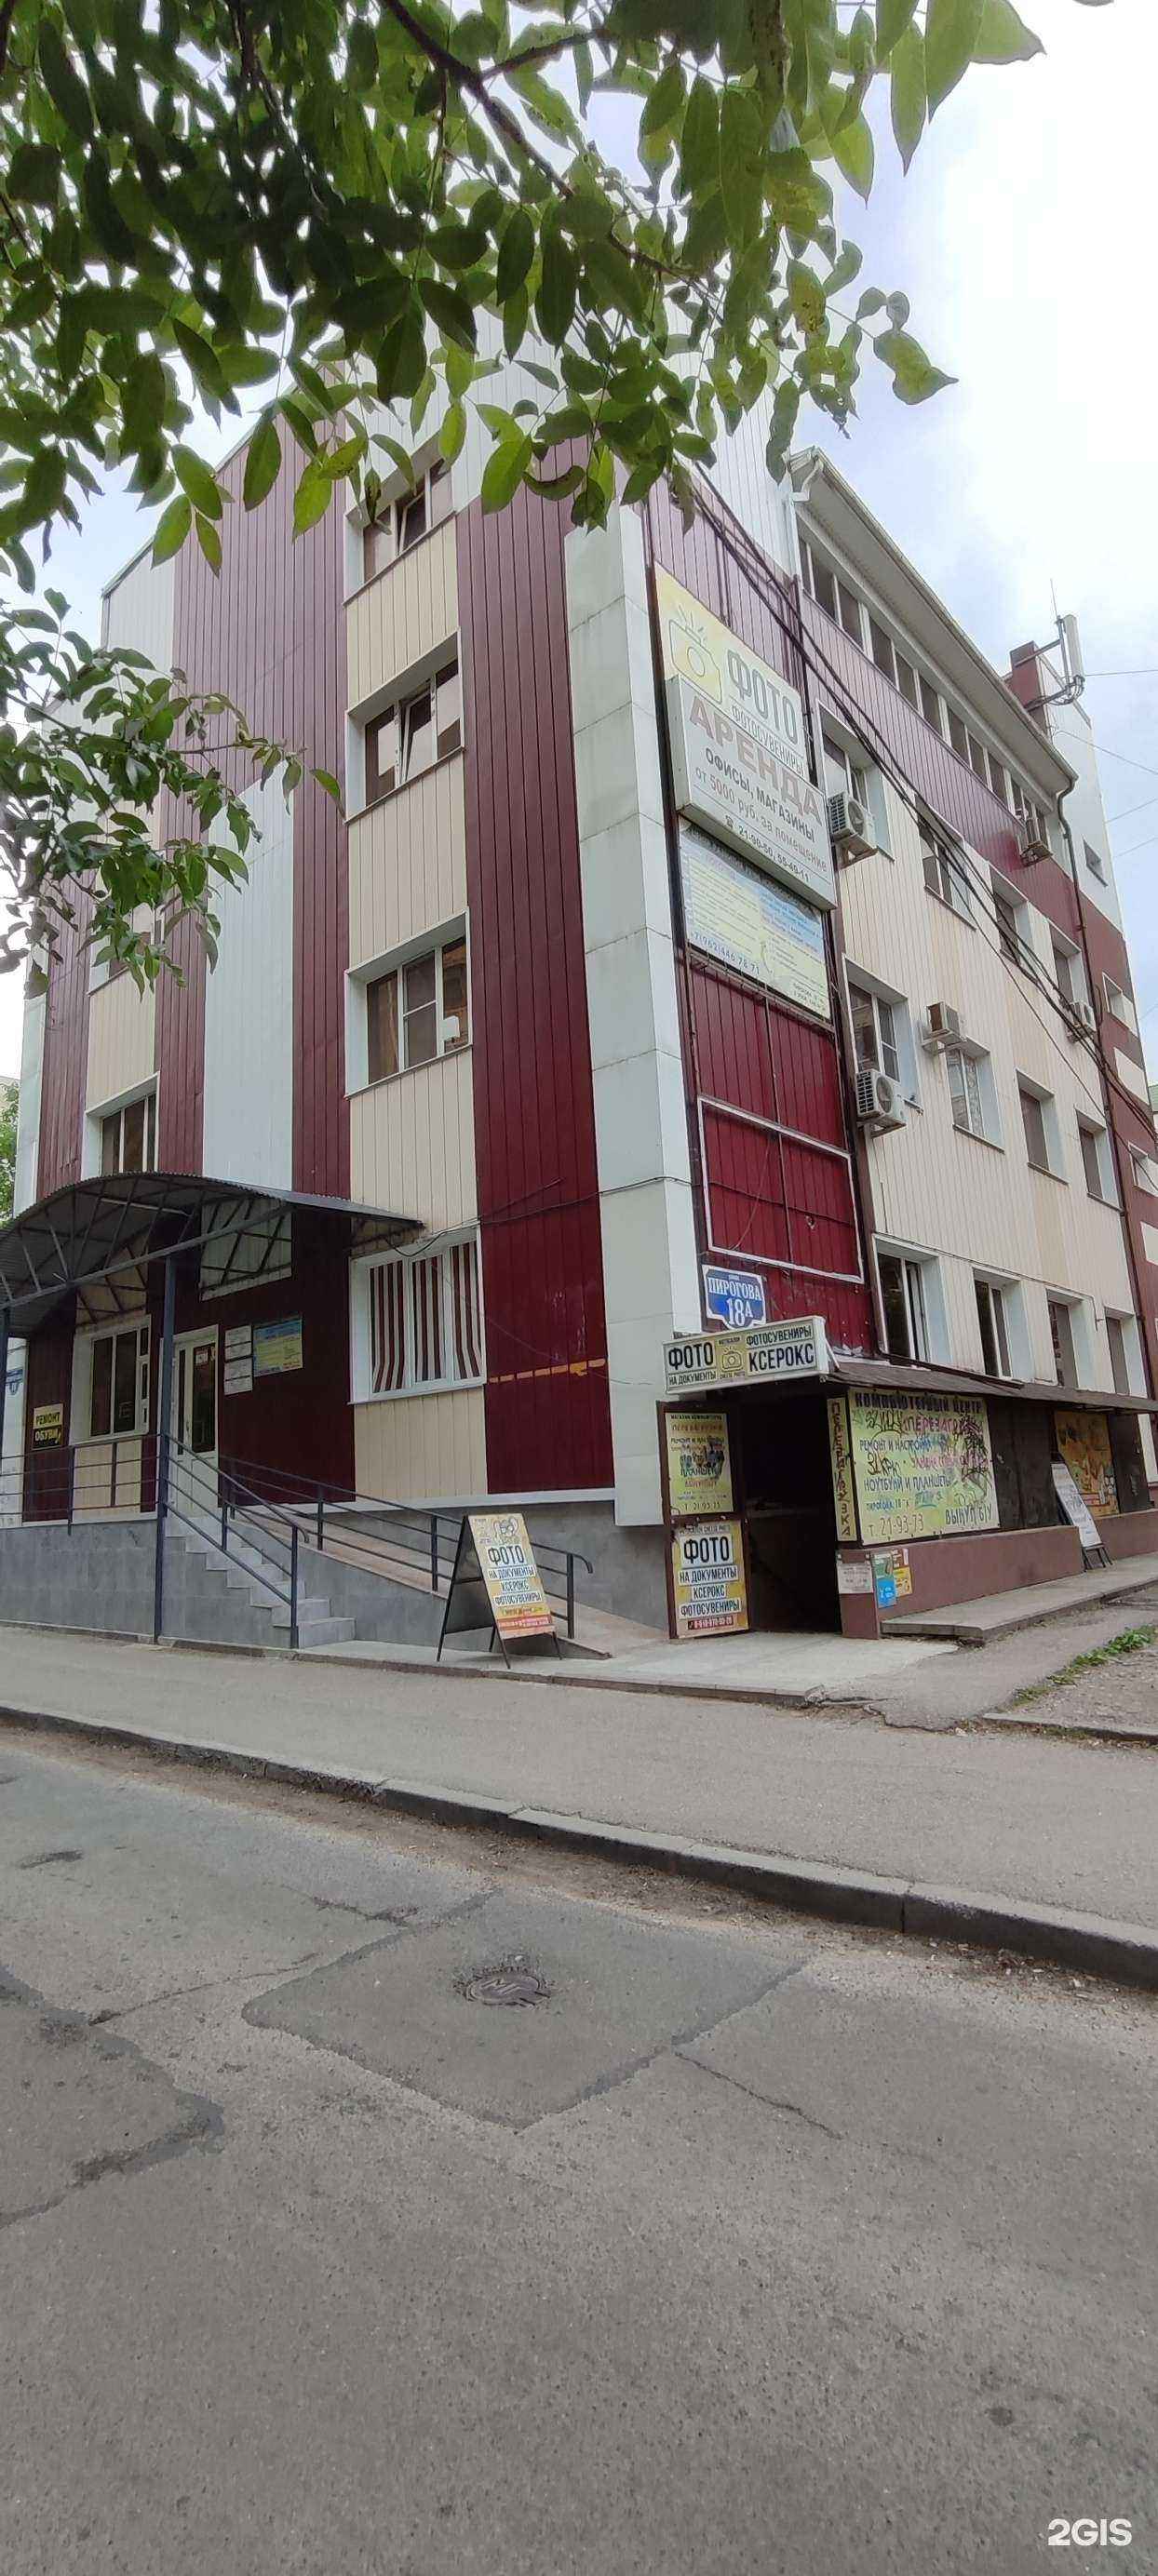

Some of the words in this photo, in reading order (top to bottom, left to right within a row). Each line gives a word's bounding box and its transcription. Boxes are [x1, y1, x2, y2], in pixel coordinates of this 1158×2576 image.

[727, 649, 799, 745] ФОТО
[731, 704, 804, 778] ФОТОСУВЕНИРЫ
[690, 695, 823, 827] АРЕНДА
[706, 747, 754, 799] ОФИСЫ,
[756, 786, 815, 843] МАГАЗИНЫ
[695, 766, 707, 783] от
[709, 773, 735, 805] 5000
[761, 815, 773, 833] за
[775, 826, 828, 873] помещение
[707, 1278, 762, 1301] ПИРОГОВА
[746, 1324, 812, 1347] ФОТОСУВЕНИРЫ
[667, 1342, 714, 1371] ФОТО
[748, 1343, 815, 1373] КСЕРОКС
[668, 1375, 678, 1386] НА
[679, 1371, 717, 1386] ДОКУМЕНТЫ
[36, 1412, 61, 1425] РЕМОНТ
[859, 1439, 886, 1452] РЕМОНТ
[880, 1513, 923, 1536] 21-93-73
[946, 1507, 976, 1526] ВЫКУП
[488, 1545, 525, 1565] ФОТО
[683, 1536, 730, 1564] ФОТО
[489, 1569, 498, 1579] НА
[498, 1565, 534, 1579] ДОКУМЕНТЫ
[680, 1571, 690, 1583] НА
[692, 1566, 736, 1583] ДОКУМЕНТЫ
[501, 1580, 529, 1591] КСЕРОКС
[693, 1585, 725, 1600] КСЕРОКС
[494, 1592, 542, 1605] ФОТОСУВЕНИРЫ
[680, 1599, 740, 1617] ФОТОСУВЕНИРЫ
